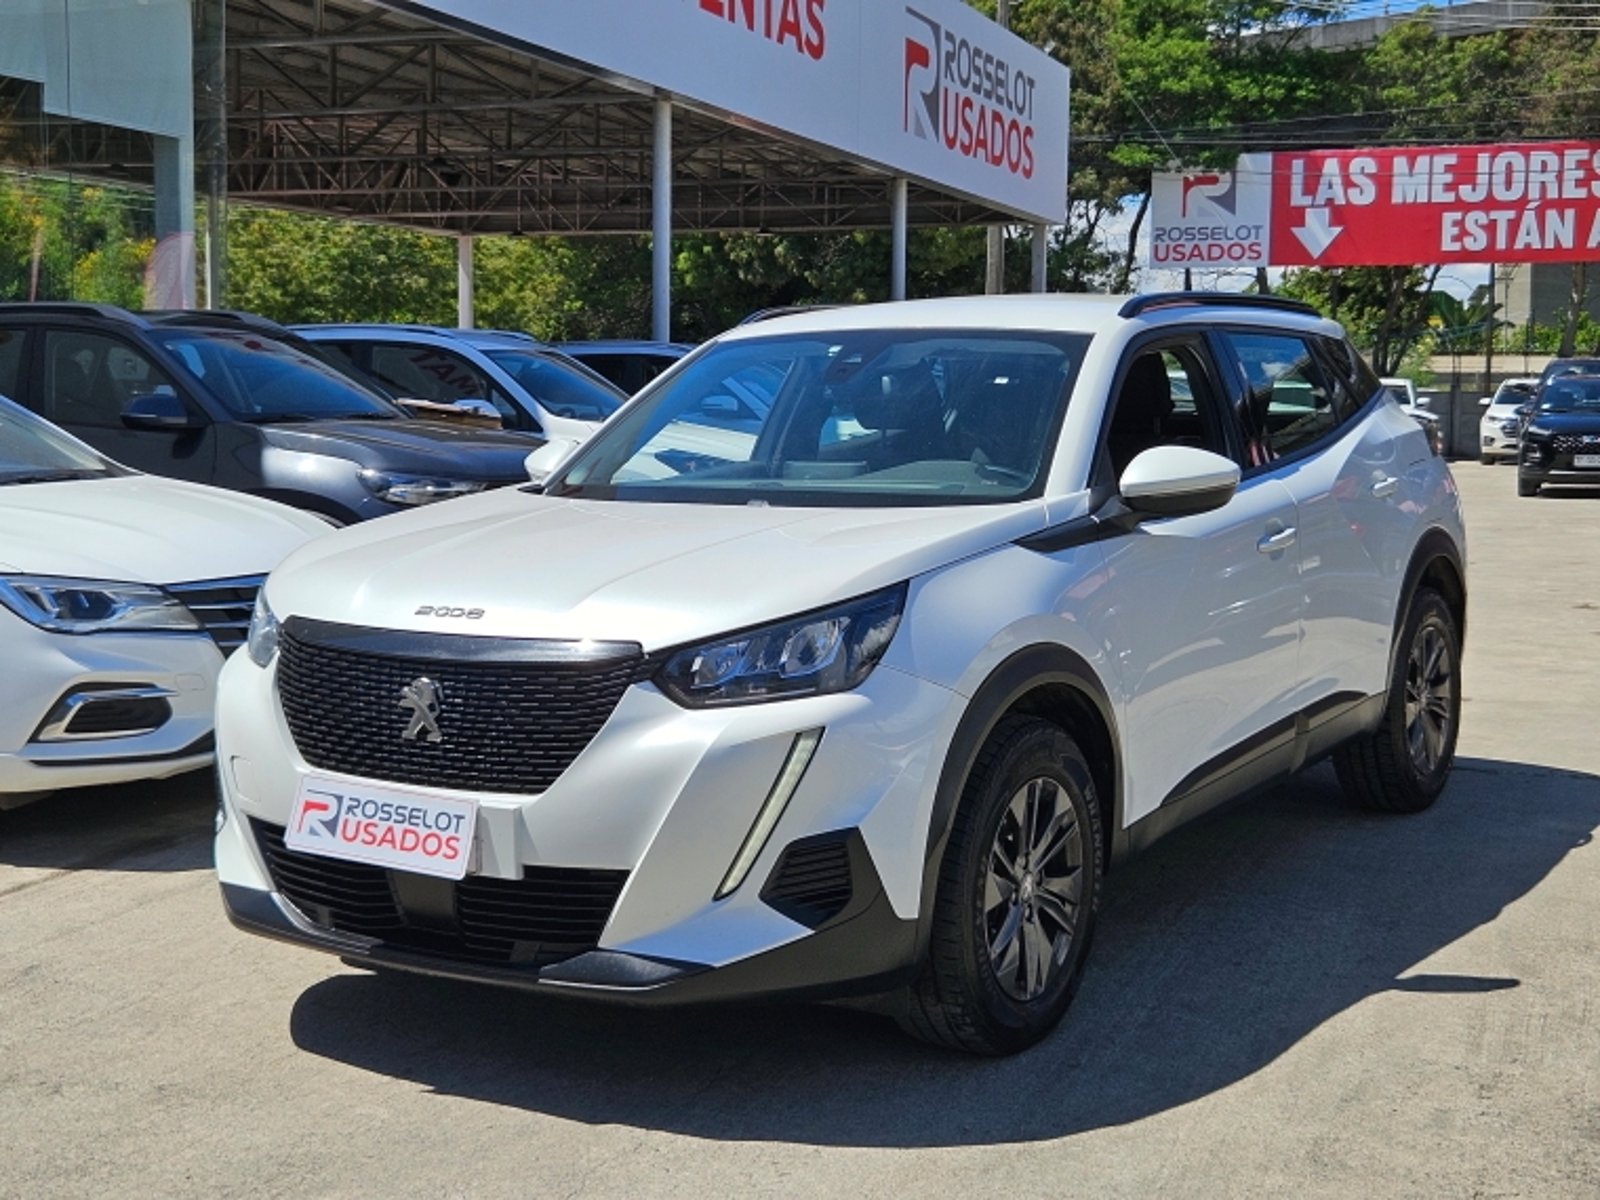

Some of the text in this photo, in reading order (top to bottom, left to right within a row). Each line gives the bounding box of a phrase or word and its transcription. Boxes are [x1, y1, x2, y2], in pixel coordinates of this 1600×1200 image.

[944, 30, 1036, 121] ROSSELOT
[943, 86, 1035, 180] USADOS
[1290, 156, 1378, 207] LAS
[1154, 224, 1264, 243] ROSSELOT
[1441, 201, 1576, 252] ESTÁN
[1153, 241, 1263, 263] USADOS
[414, 605, 485, 620] 2008
[345, 797, 466, 834] ROSSELOT
[340, 818, 461, 860] USADOS
